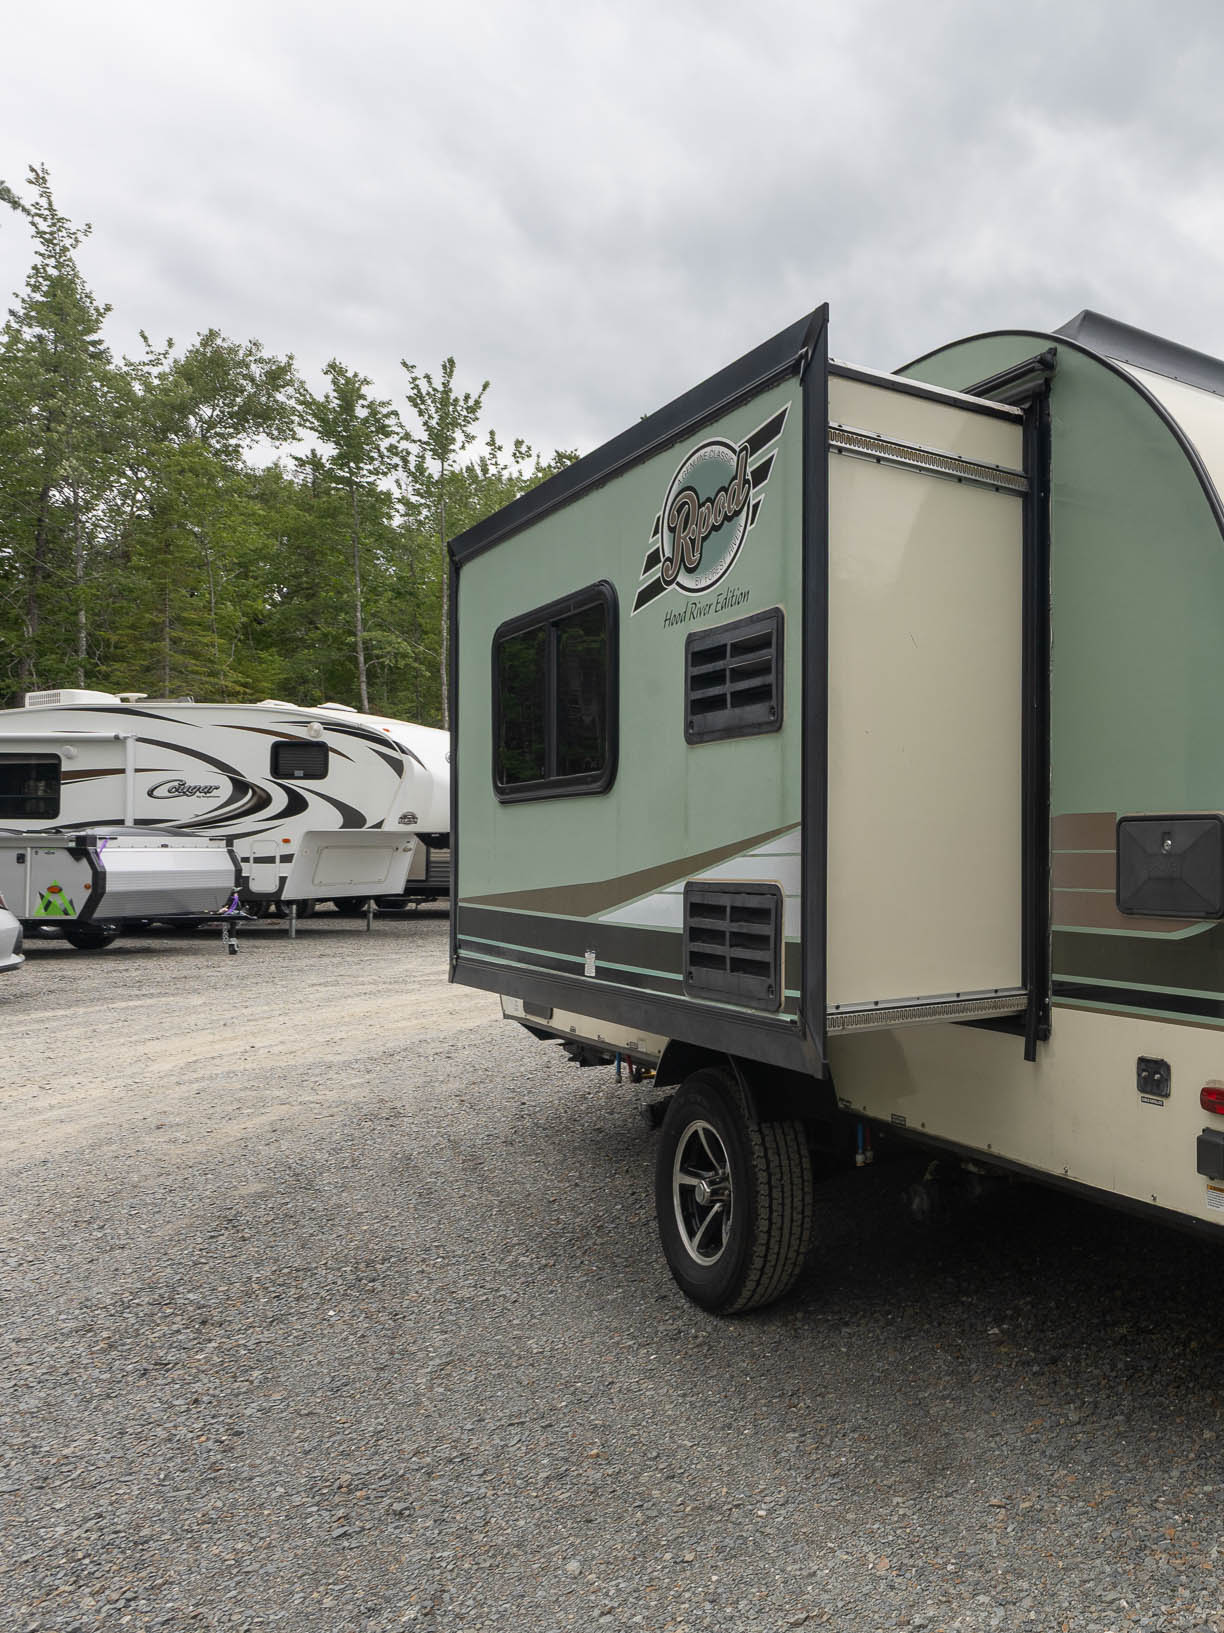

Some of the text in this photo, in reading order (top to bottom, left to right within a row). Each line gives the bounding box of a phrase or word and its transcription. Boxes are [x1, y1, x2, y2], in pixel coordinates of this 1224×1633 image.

[664, 587, 750, 629] Hood River Edition
[147, 779, 220, 799] Cougar
